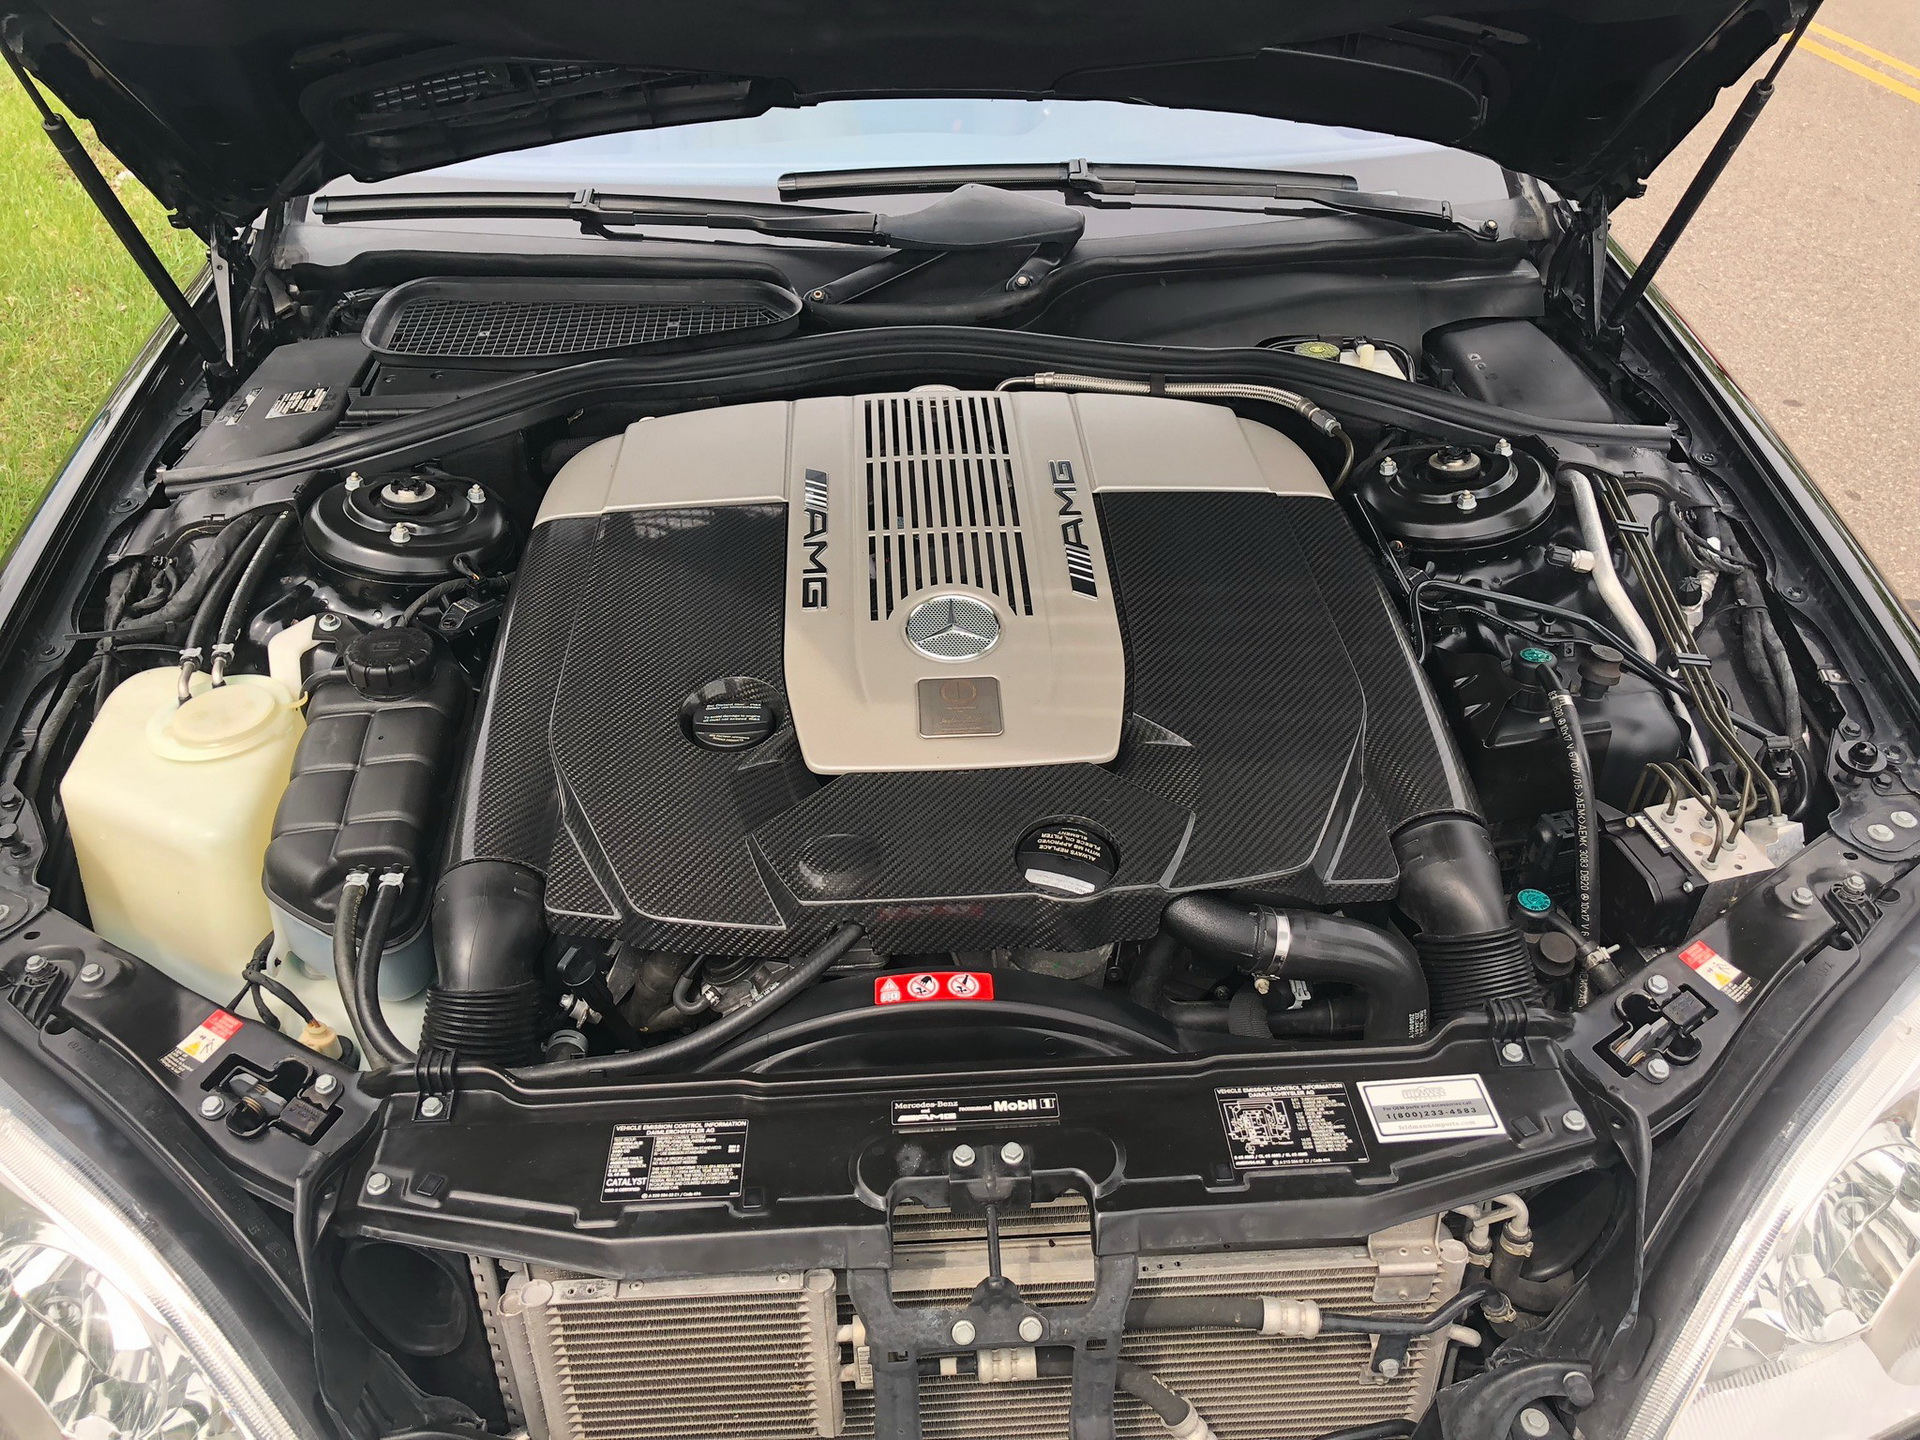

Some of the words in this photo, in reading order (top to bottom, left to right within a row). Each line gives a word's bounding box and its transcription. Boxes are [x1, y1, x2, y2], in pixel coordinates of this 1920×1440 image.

[1048, 460, 1089, 550] AMG
[802, 508, 828, 609] AMG
[1037, 838, 1072, 848] APPROVED
[1039, 844, 1069, 853] REPLACE
[1070, 850, 1096, 862] ALWAYS
[1084, 847, 1101, 857] WITH
[1579, 849, 1588, 868] 3083
[1580, 870, 1590, 891] DB20
[895, 1101, 958, 1110] Mercedes-Benz
[993, 1099, 1037, 1112] Mobil
[1386, 1107, 1477, 1120] 1(800)233-4583
[1398, 1121, 1476, 1130] feldmannimports.com
[606, 1177, 647, 1186] CATALYST
